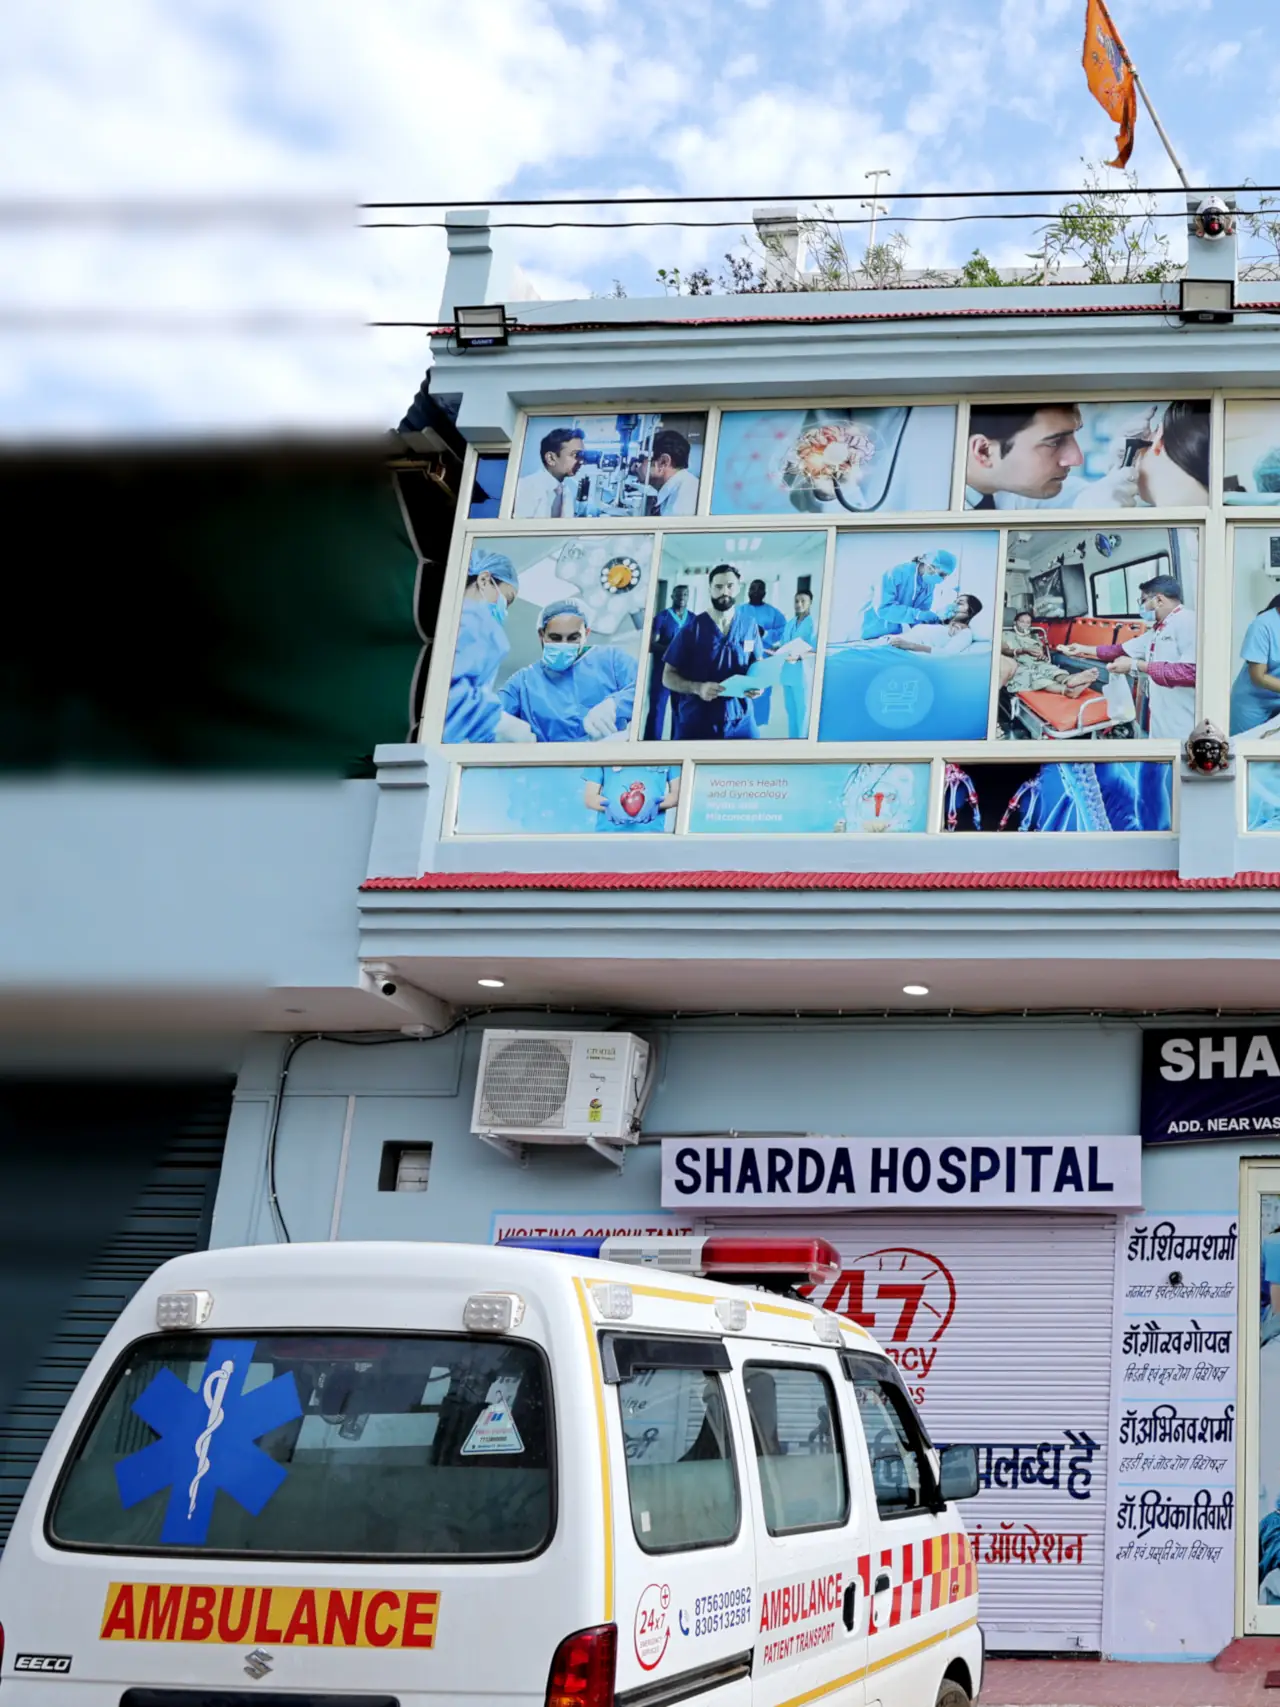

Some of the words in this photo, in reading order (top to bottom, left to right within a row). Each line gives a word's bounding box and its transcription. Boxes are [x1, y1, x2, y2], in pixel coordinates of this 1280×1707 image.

[757, 778, 788, 787] Health
[1167, 1120, 1204, 1134] ADD.
[1207, 1118, 1250, 1131] NEAR
[674, 1147, 855, 1195] SHARDA
[870, 1146, 1113, 1194] HOSPITAL
[100, 1584, 439, 1648] AMBULANCE
[695, 1586, 751, 1616] 8756300962
[759, 1572, 843, 1634] AMBULANCE
[695, 1608, 751, 1637] 8305132581
[763, 1634, 795, 1666] PATIENT
[795, 1622, 835, 1654] TRANSPORT
[15, 1657, 71, 1671] EECO
